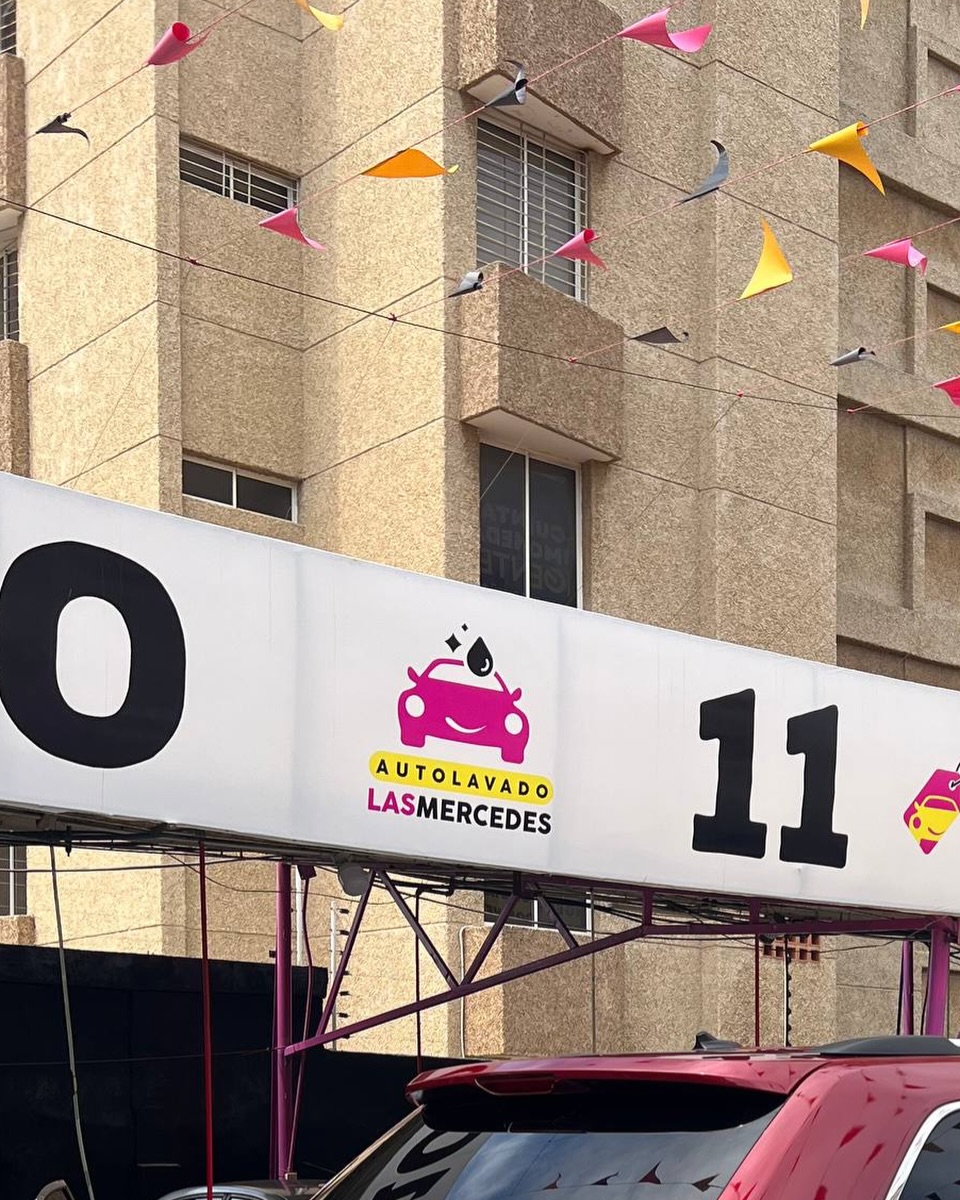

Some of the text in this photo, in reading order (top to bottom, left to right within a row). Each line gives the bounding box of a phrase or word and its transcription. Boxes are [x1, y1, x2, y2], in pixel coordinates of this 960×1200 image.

[376, 758, 549, 799] AUTOLAVADO
[692, 688, 849, 869] 11
[367, 787, 552, 835] LASMERCEDES
